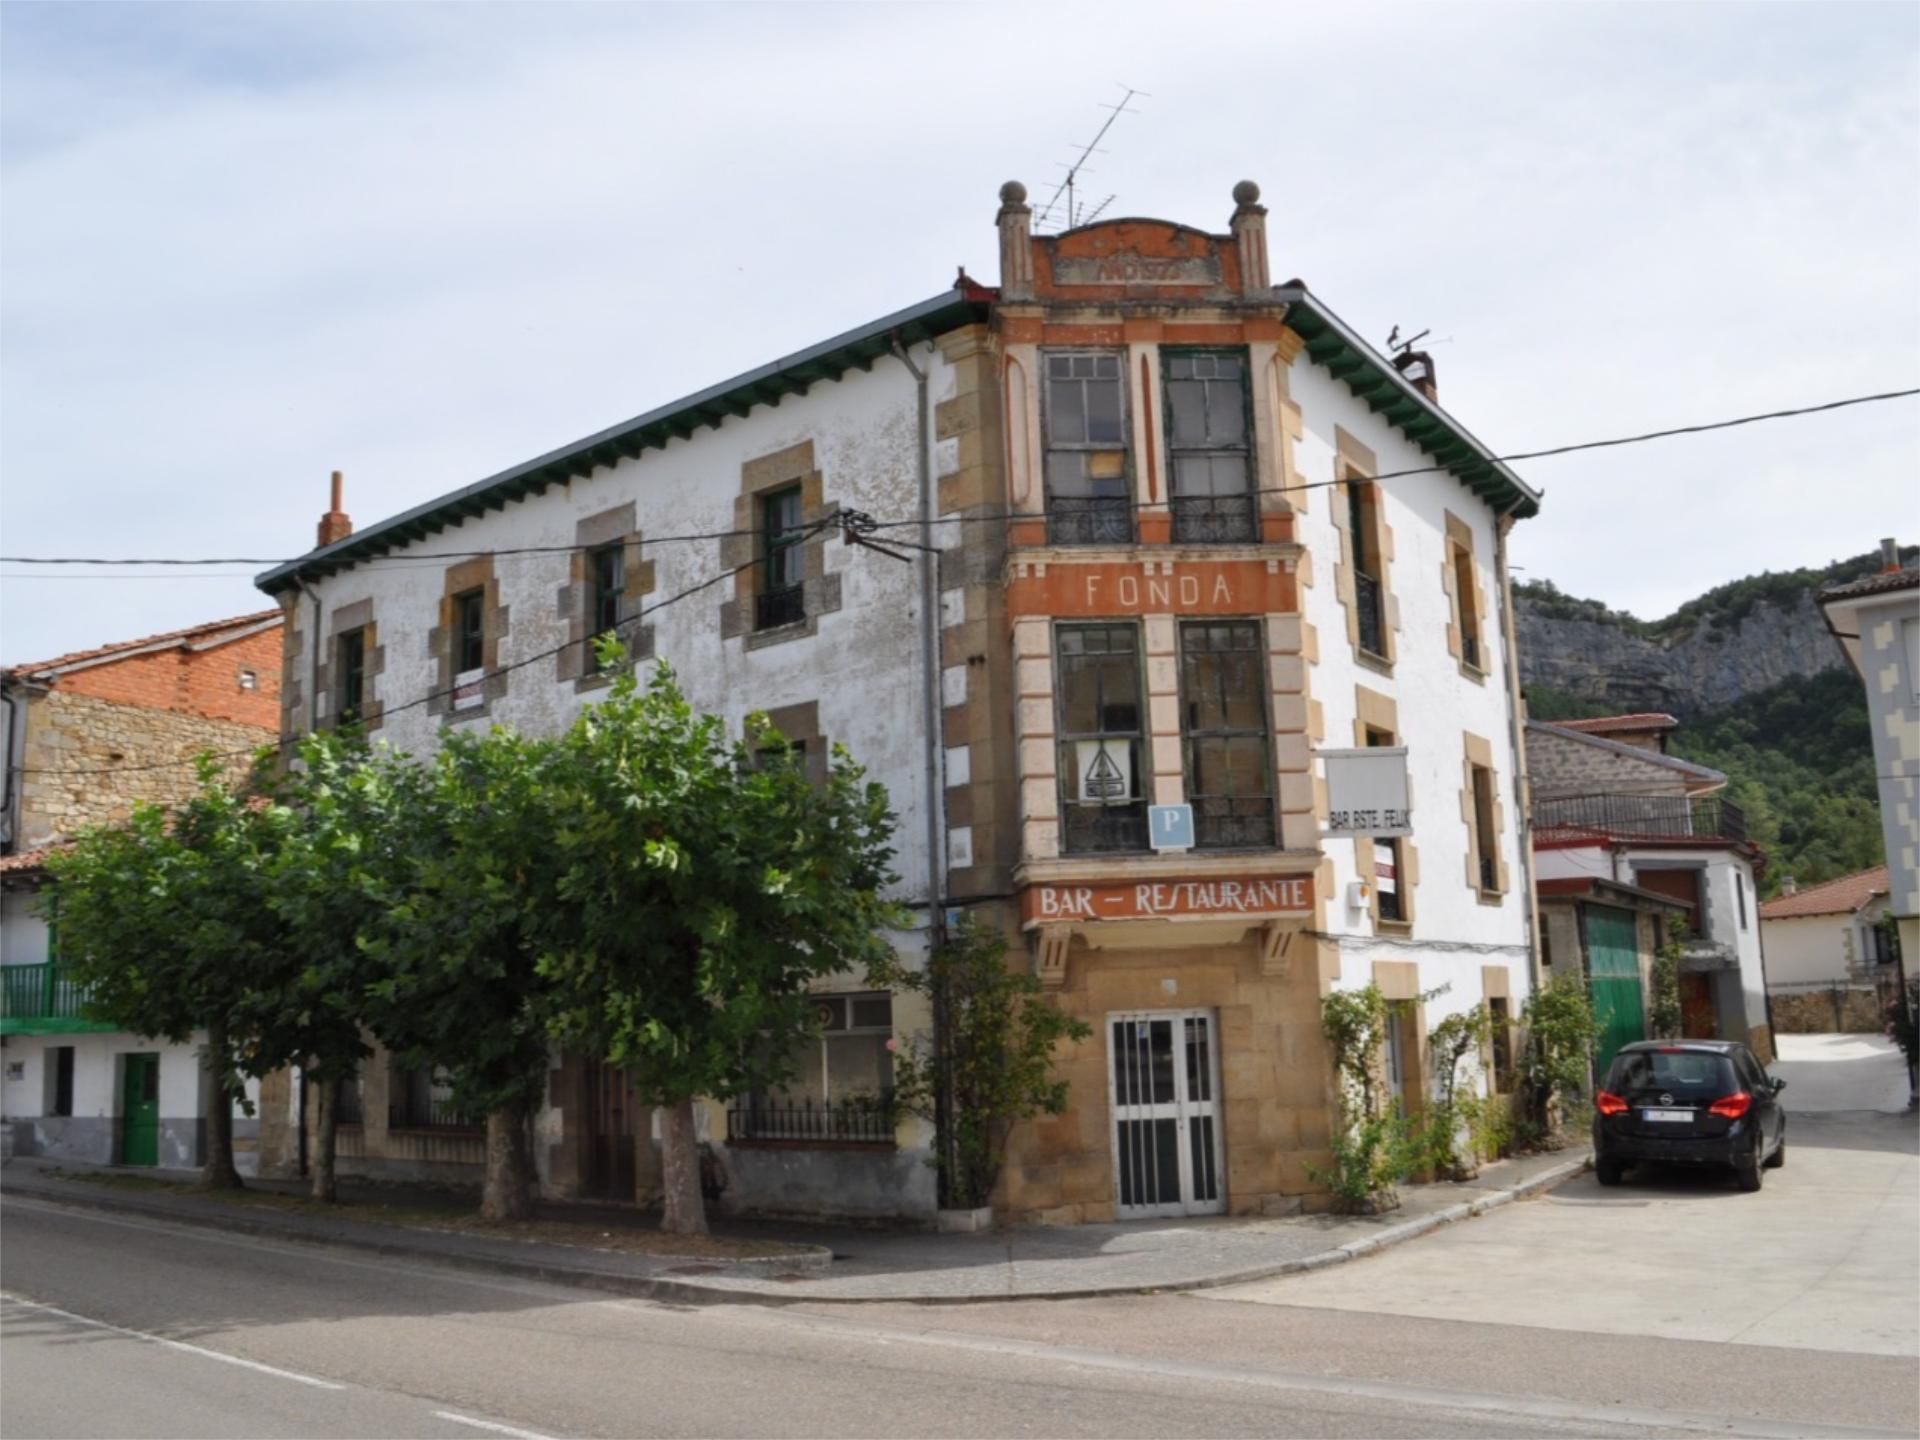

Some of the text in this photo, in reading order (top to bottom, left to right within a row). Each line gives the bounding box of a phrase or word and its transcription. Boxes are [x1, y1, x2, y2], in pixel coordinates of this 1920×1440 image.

[1086, 574, 1231, 606] FONDA
[1163, 810, 1181, 832] P
[1330, 810, 1349, 830] BAR
[1040, 888, 1096, 917] BAR
[1135, 879, 1307, 914] RESTAURANTE
